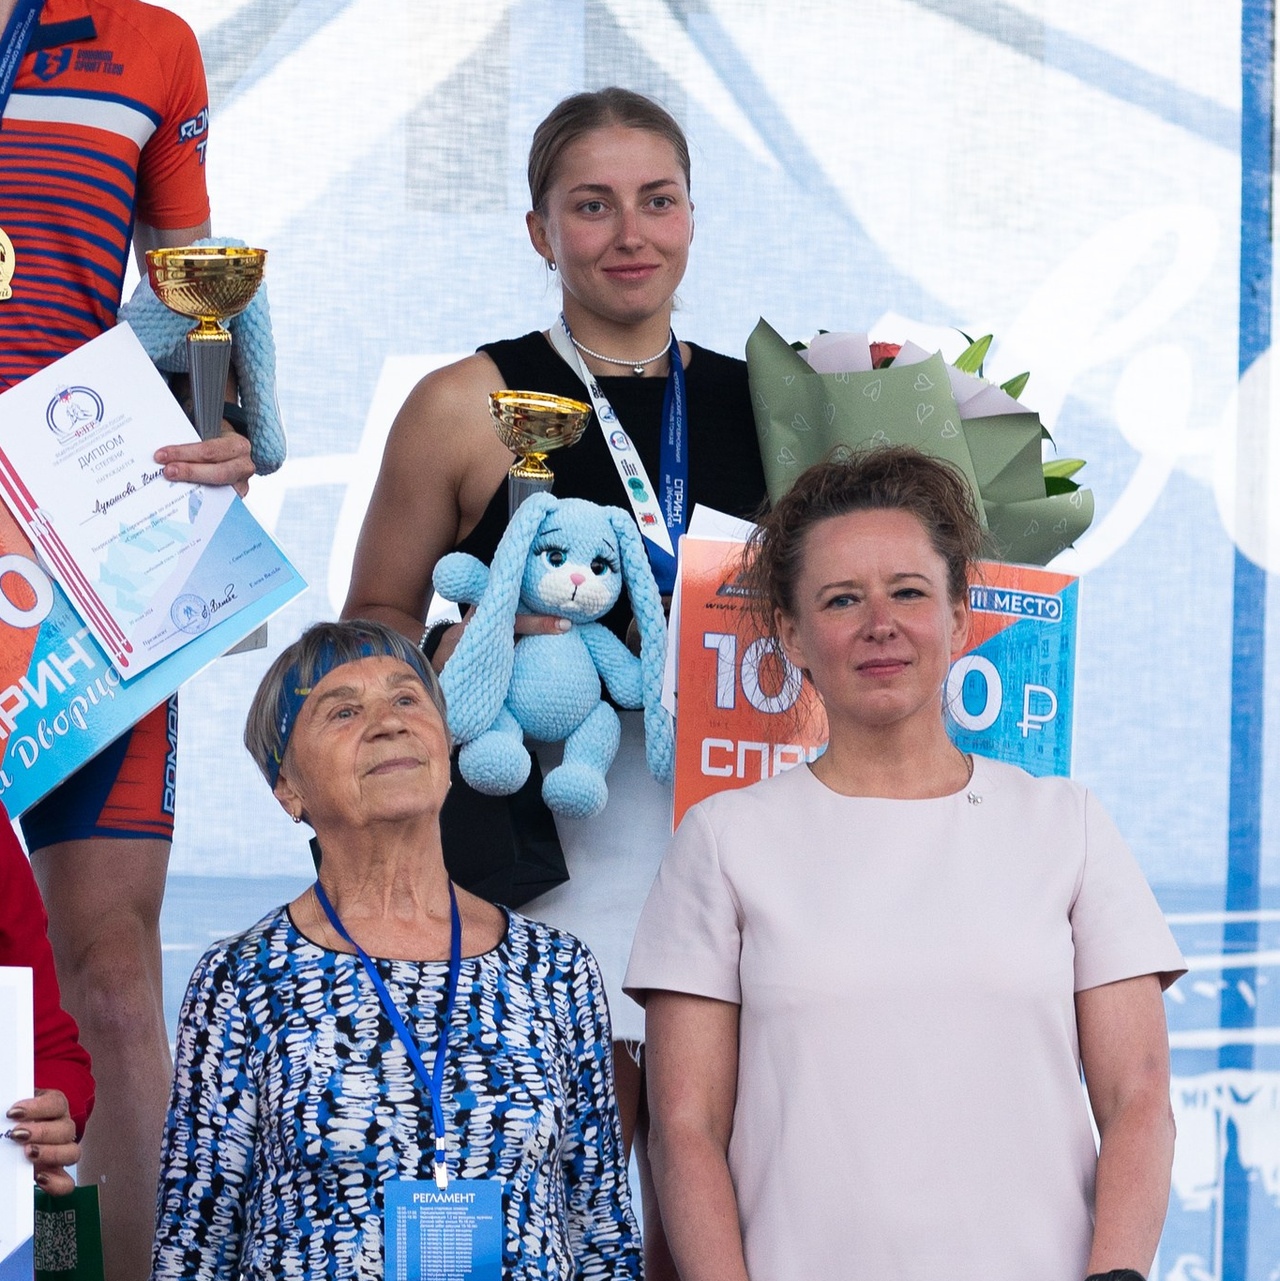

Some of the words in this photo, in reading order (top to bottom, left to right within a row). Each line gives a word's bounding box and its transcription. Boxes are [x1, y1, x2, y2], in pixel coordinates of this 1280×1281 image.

[77, 434, 125, 470] ДИПЛОМ
[95, 450, 125, 472] СТЕПЕНИ
[673, 479, 684, 524] СПРИНТ
[993, 588, 1062, 619] МЕСТО
[10, 664, 123, 771] Дворцо
[413, 1192, 477, 1204] РЕГЛАМЕНТ
